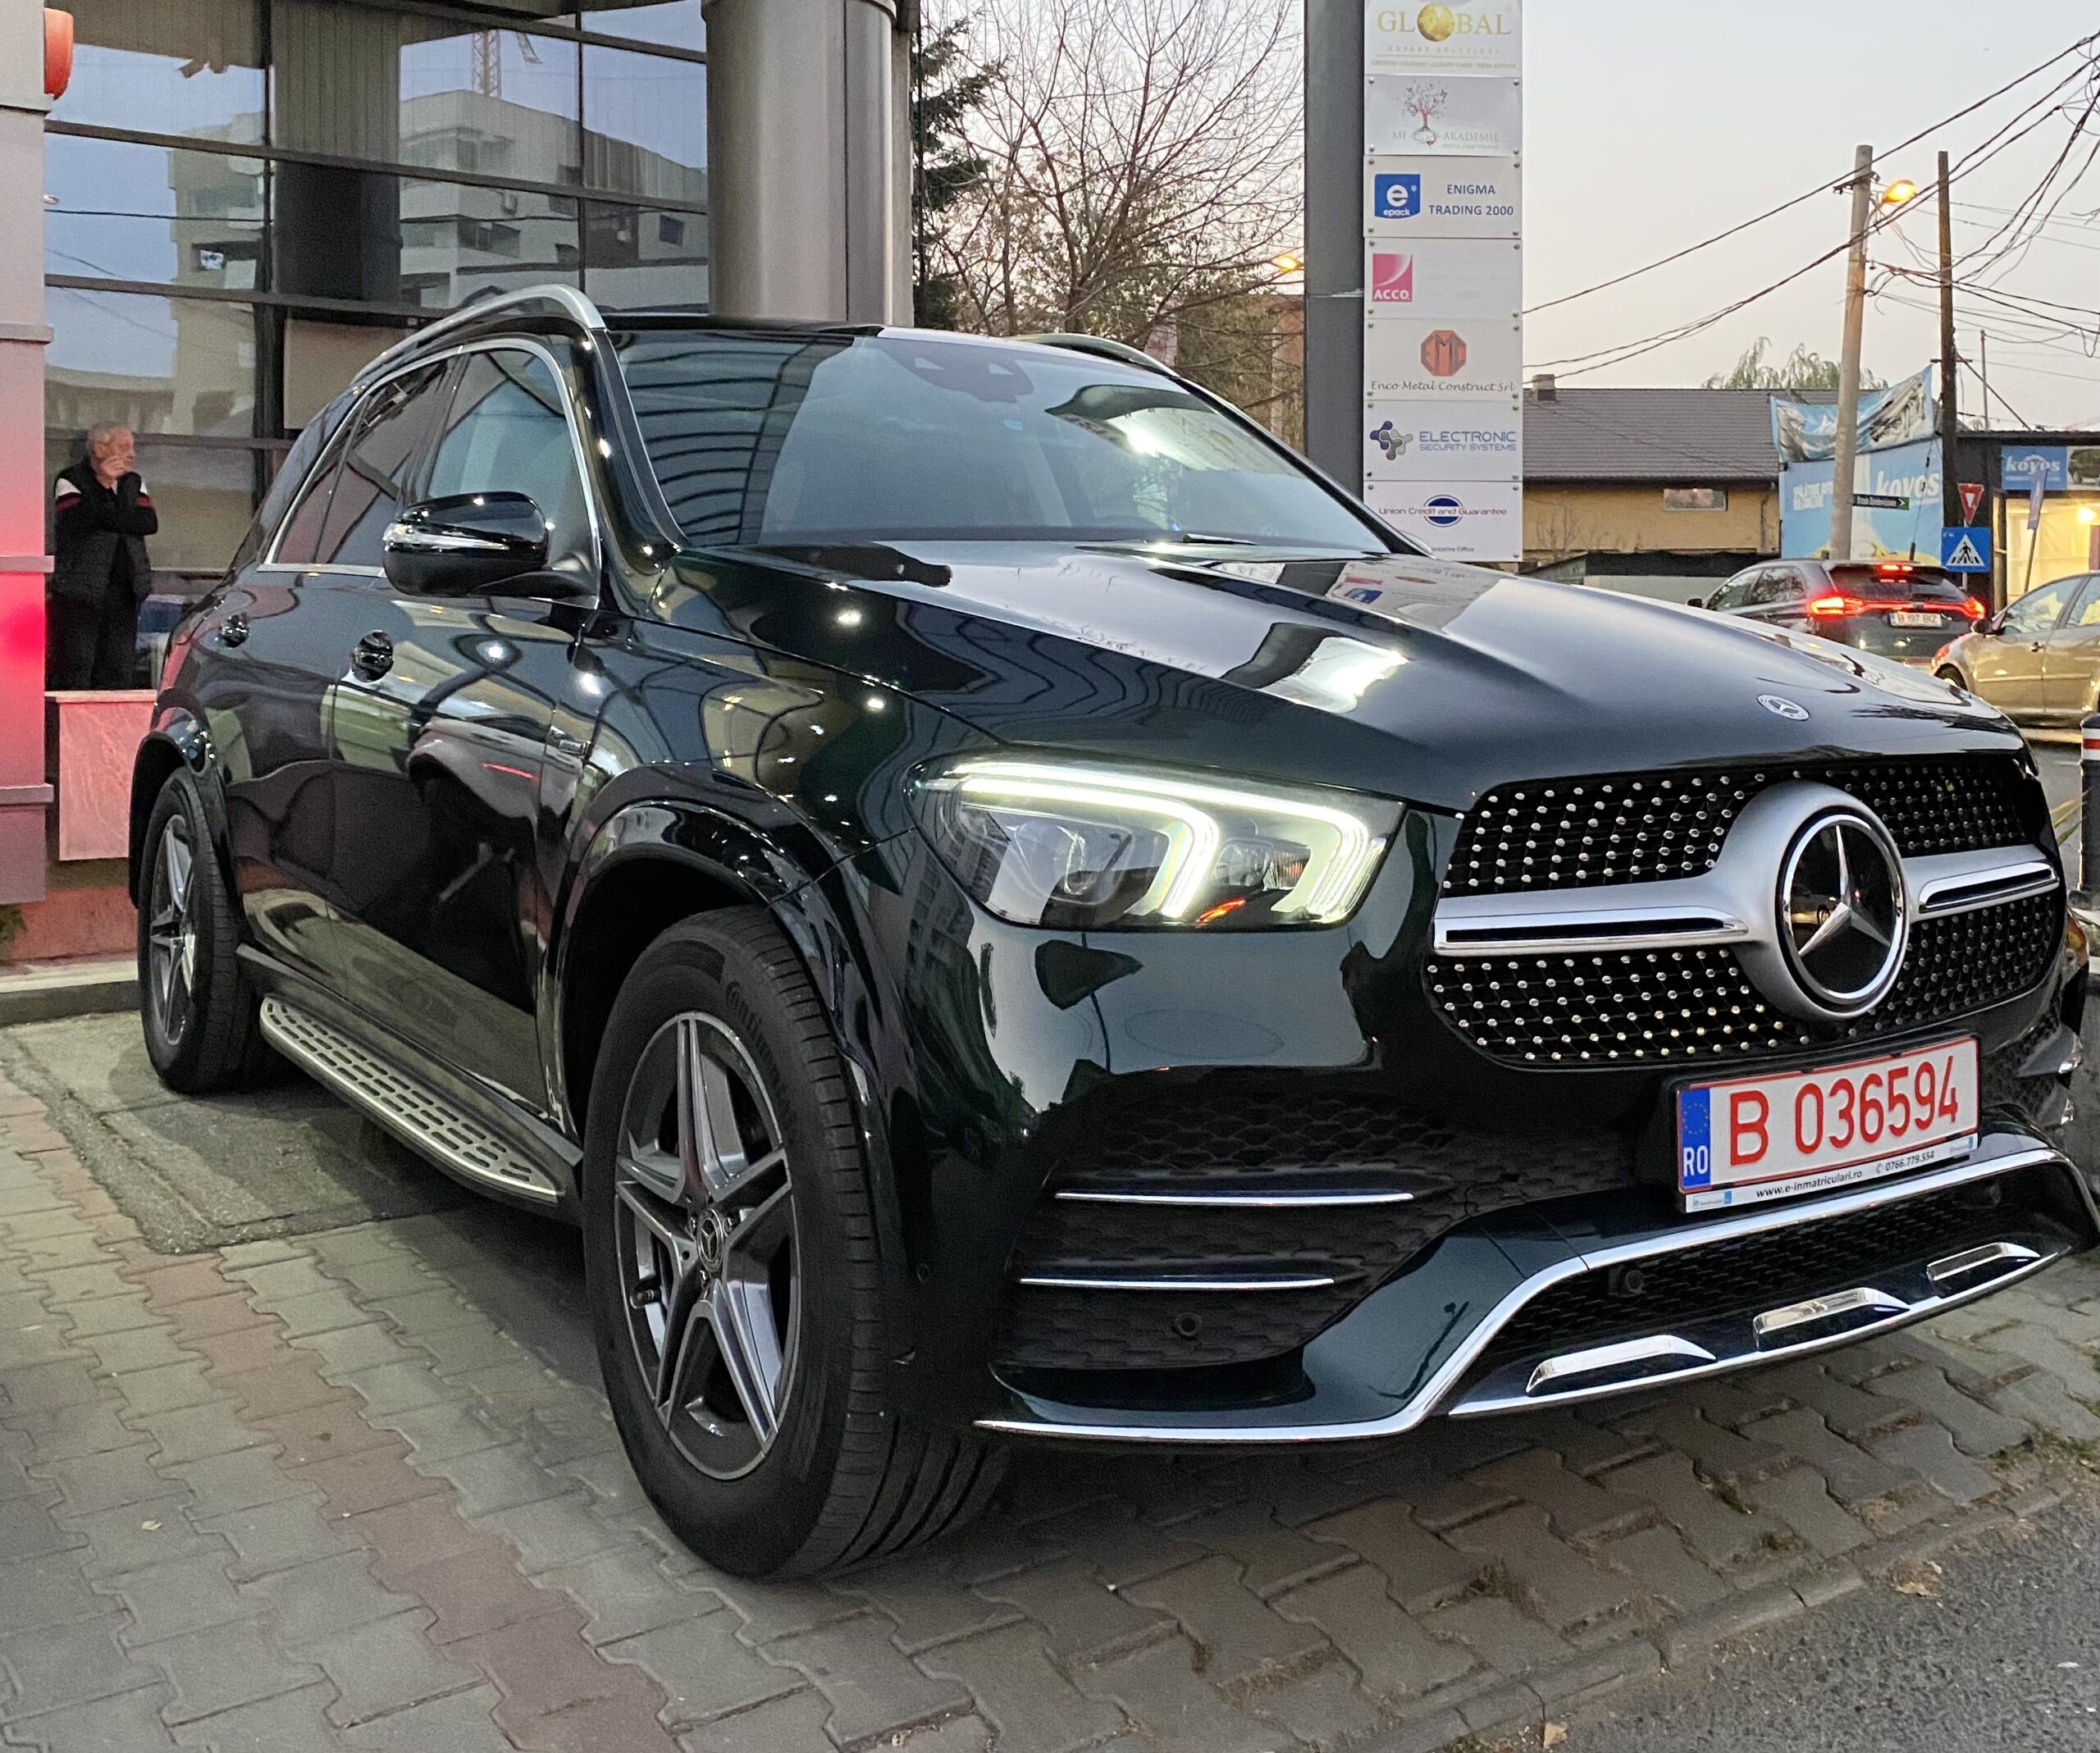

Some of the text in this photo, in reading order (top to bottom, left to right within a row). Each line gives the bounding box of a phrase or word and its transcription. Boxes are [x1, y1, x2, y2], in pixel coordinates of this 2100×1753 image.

[1443, 131, 1500, 142] AKADEMIE
[1447, 185, 1495, 195] ENIGMA
[1383, 208, 1410, 217] epack
[1428, 205, 1513, 216] TRADING 2000
[1373, 289, 1409, 300] ACCO
[1371, 381, 1516, 392] Enco Metal Construct Srl
[1419, 431, 1516, 443] ELECTRONIC
[1379, 507, 1507, 516] Union Credit and Guarantee
[1729, 1055, 1959, 1166] B 036594
[1682, 1144, 1709, 1177] RO
[1755, 1169, 1863, 1198] www.e-inmatriculari.ro
